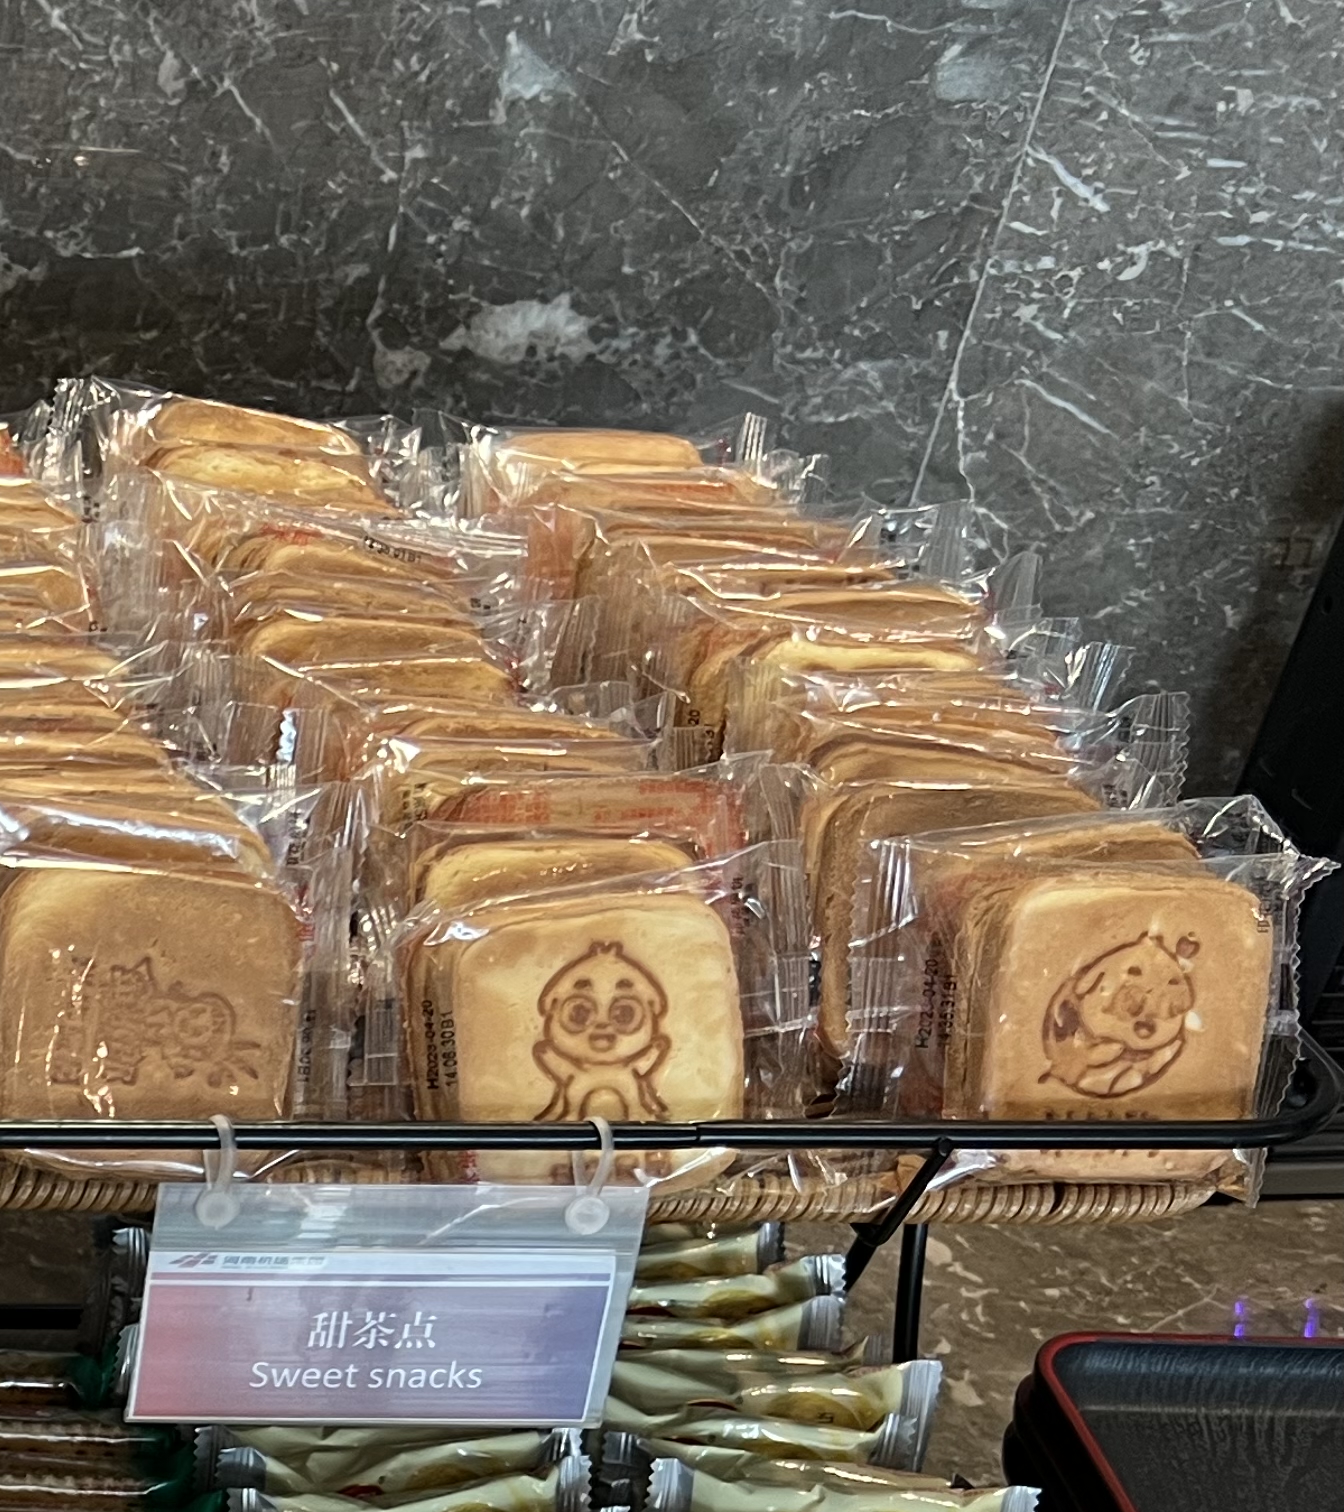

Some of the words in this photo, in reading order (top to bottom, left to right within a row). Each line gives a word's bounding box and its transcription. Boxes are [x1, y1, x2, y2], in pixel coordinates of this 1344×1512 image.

[306, 1310, 438, 1350] 甜茶点
[249, 1361, 360, 1389] Sweet
[367, 1360, 484, 1390] snacks
